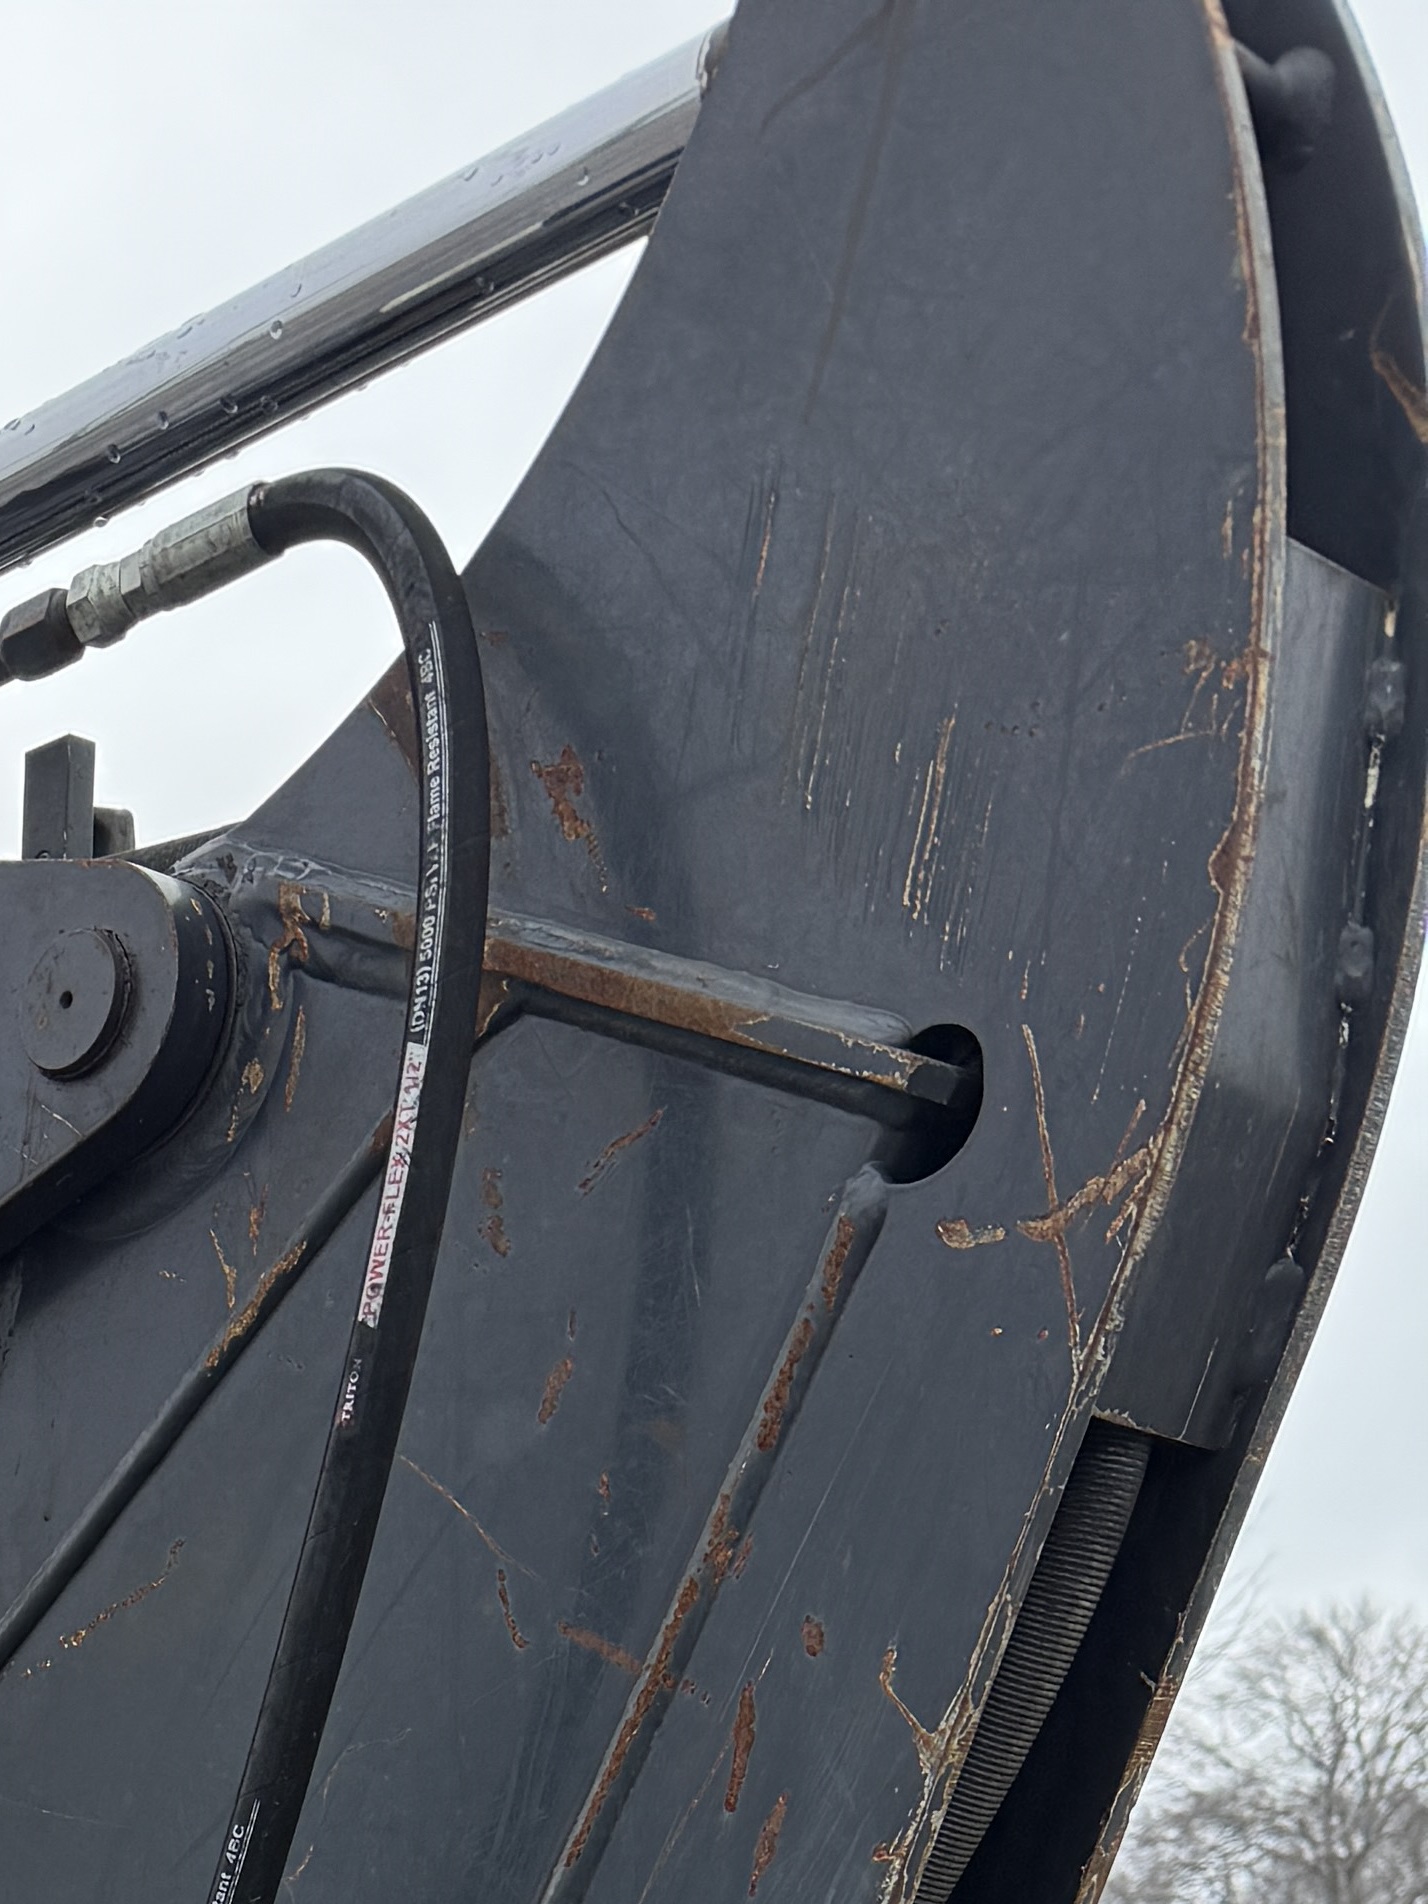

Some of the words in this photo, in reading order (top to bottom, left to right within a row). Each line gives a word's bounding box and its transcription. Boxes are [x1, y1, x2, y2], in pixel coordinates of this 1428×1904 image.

[424, 690, 441, 775] Resistant
[426, 776, 442, 835] Flame
[419, 915, 437, 961] 5000
[410, 966, 433, 1033] (DN13)
[361, 1150, 407, 1320] POWER-FLEX
[341, 1358, 363, 1421] TRITON
